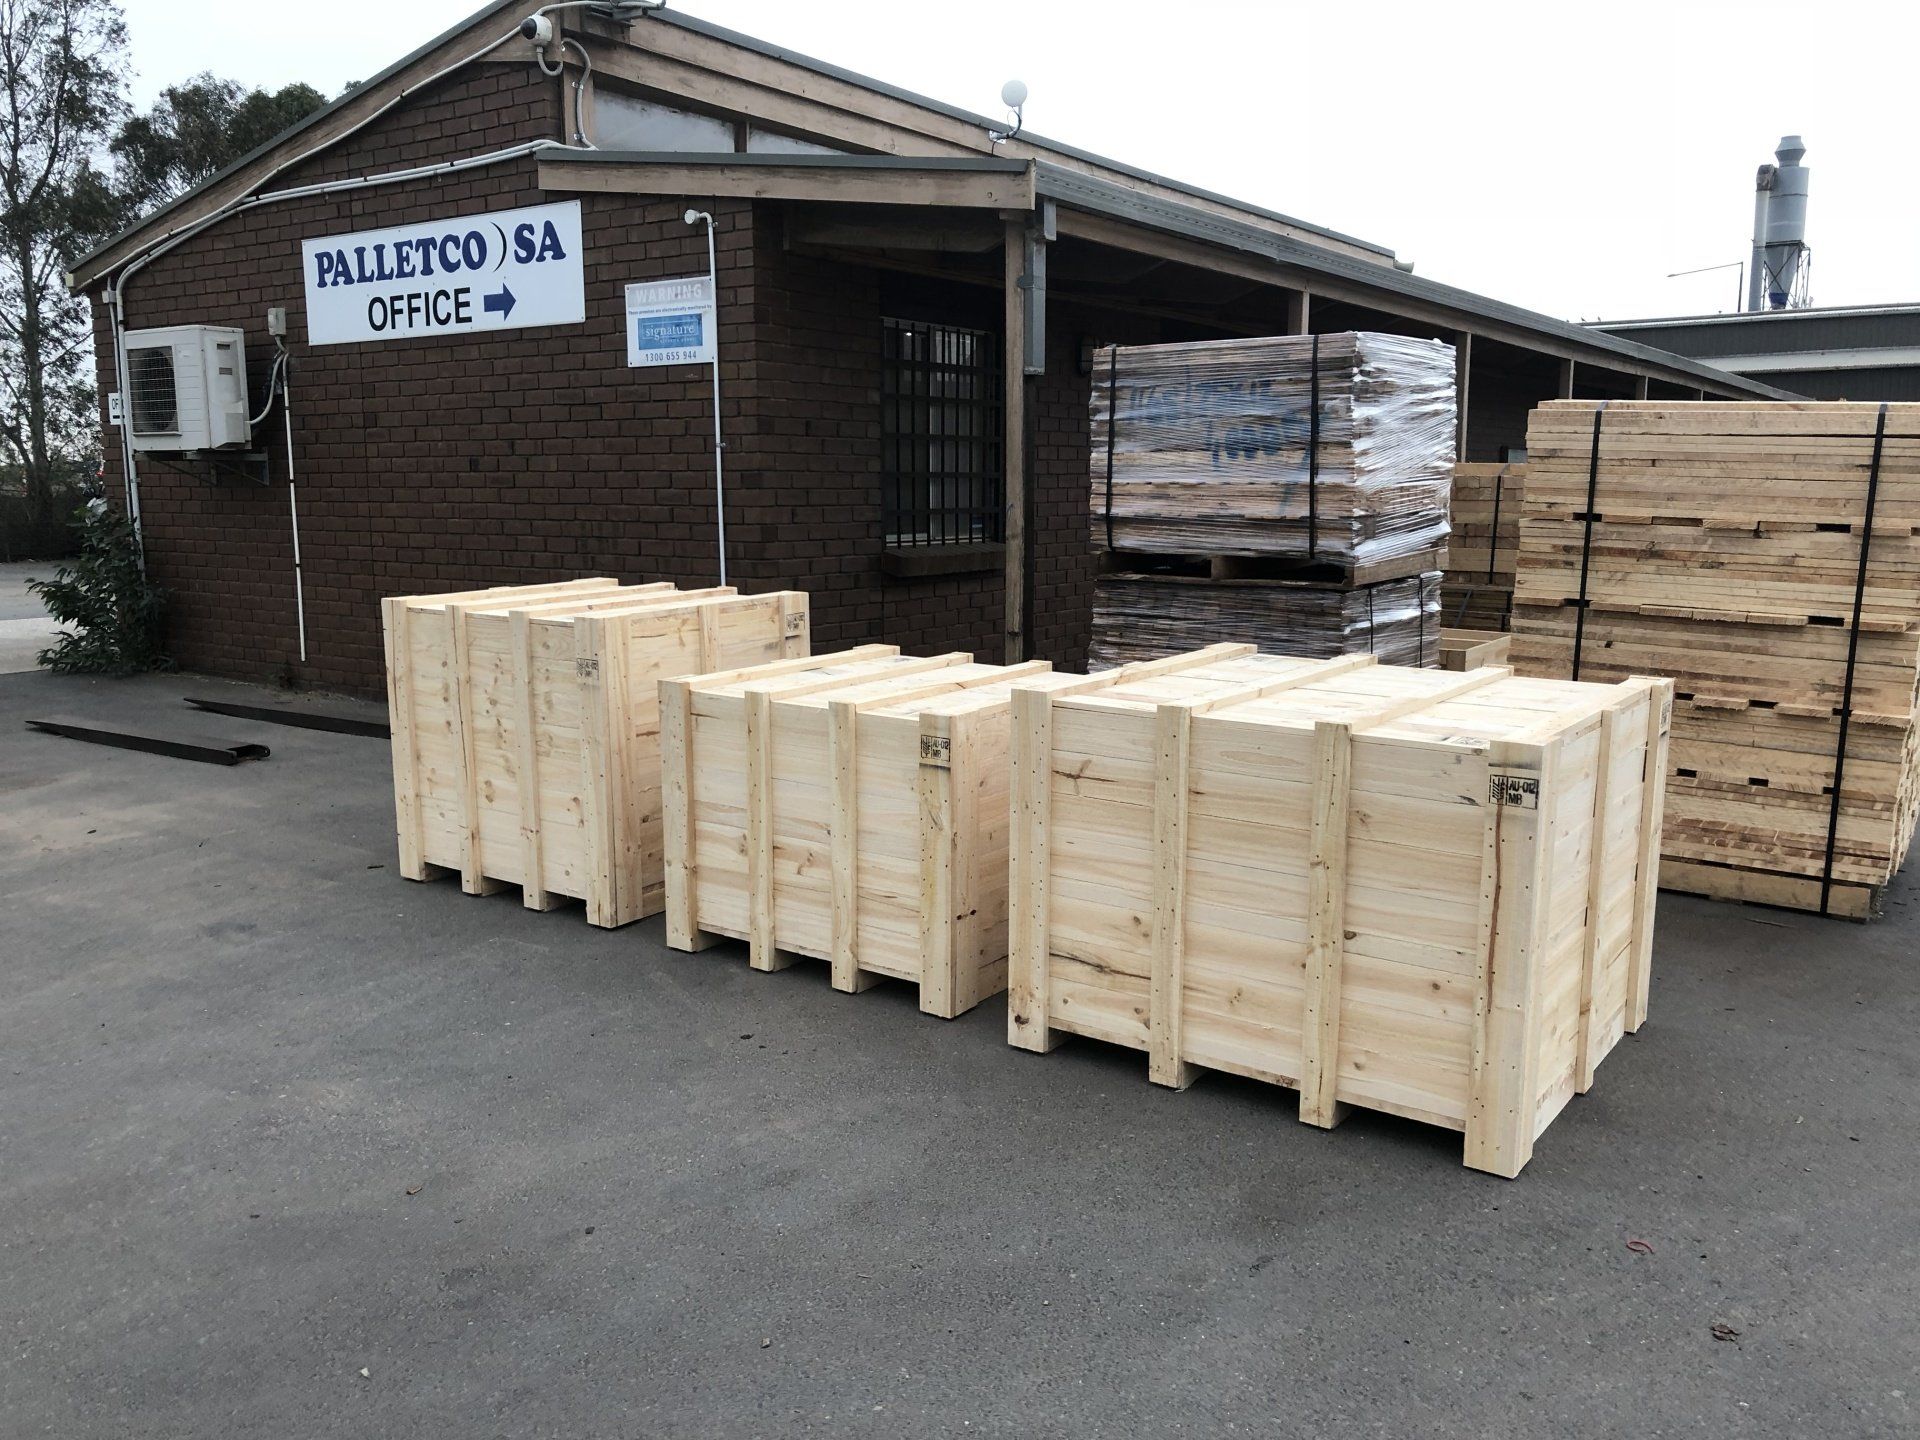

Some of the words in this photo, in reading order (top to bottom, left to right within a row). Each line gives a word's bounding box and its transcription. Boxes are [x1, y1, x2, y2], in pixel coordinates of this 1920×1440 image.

[314, 230, 488, 289] PALLETCO
[513, 219, 567, 265] SA
[635, 284, 702, 302] WARNING
[367, 286, 473, 332] OFFICE
[645, 323, 695, 341] signature
[645, 352, 664, 362] 1300
[666, 351, 680, 361] 655
[682, 350, 697, 360] 944
[1508, 780, 1536, 794] AU-012
[1508, 793, 1523, 805] MB
